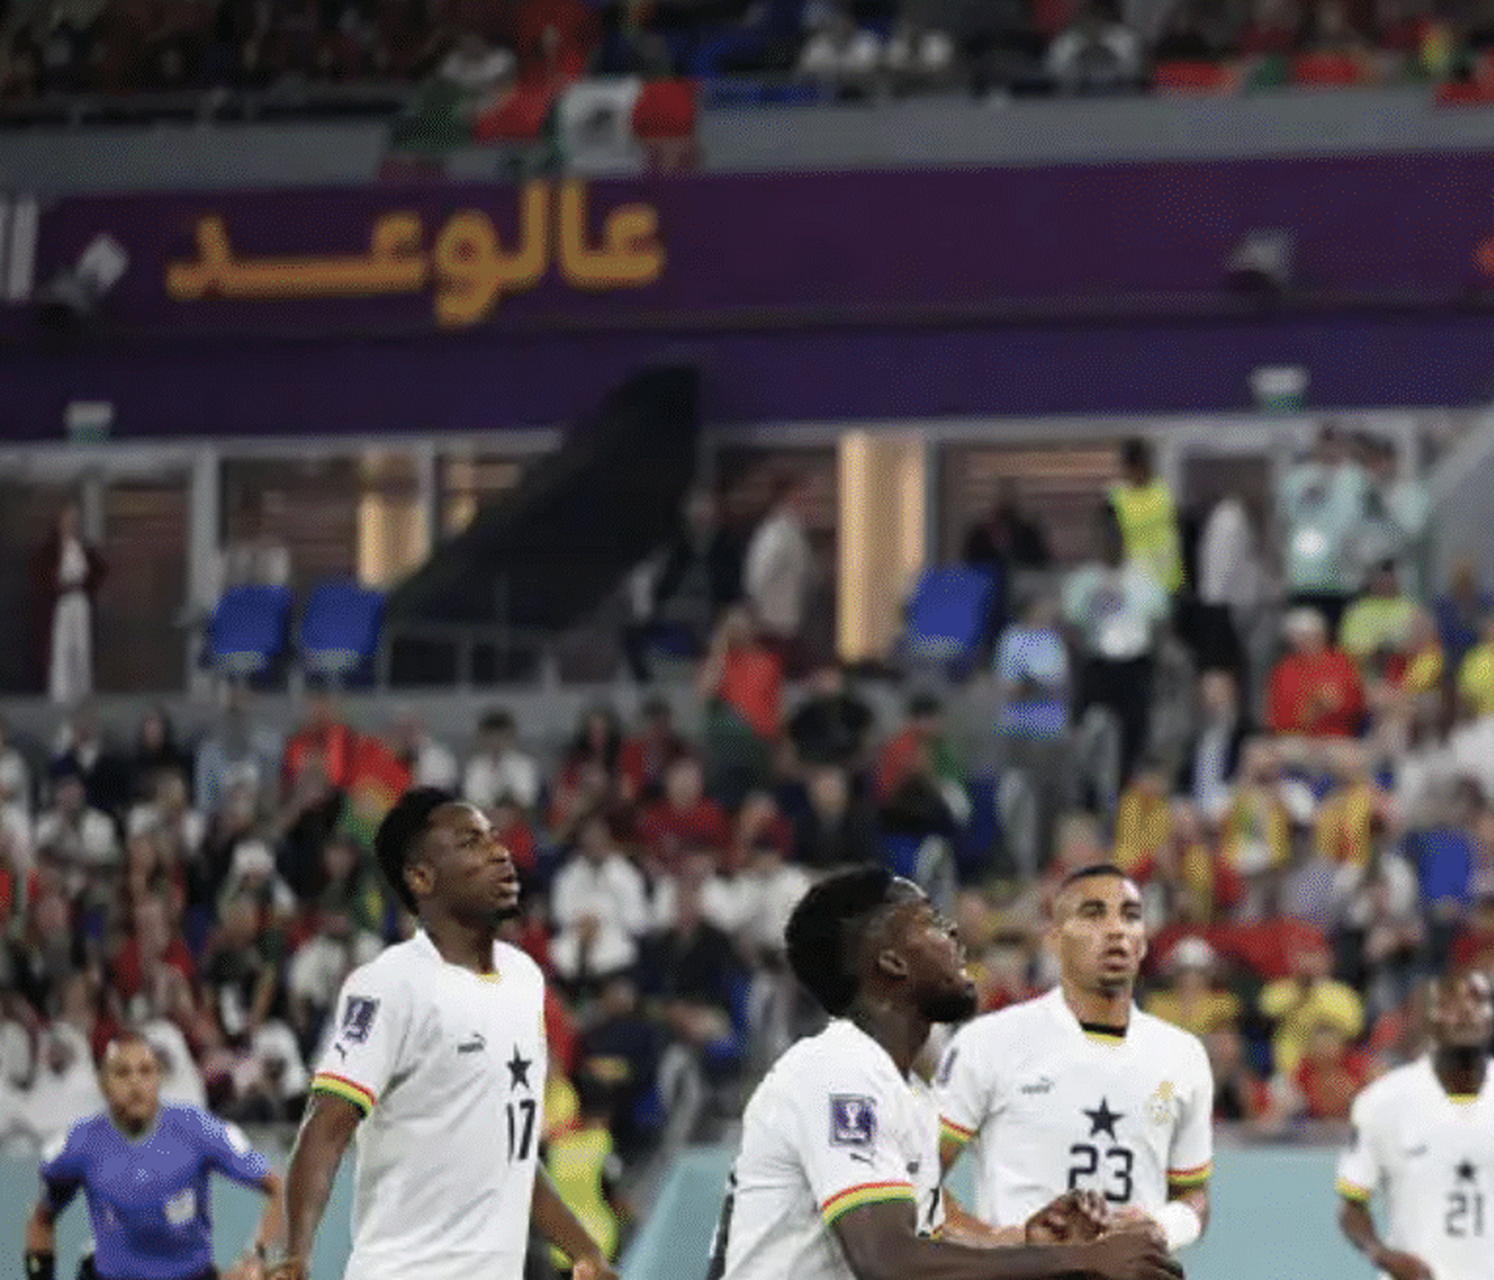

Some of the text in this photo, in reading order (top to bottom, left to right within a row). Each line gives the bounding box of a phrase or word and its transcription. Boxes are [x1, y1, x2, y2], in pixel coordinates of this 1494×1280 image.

[167, 179, 661, 325] عالوعد
[507, 1099, 535, 1164] 17
[1069, 1143, 1133, 1202] 23
[1446, 1190, 1484, 1237] 21
